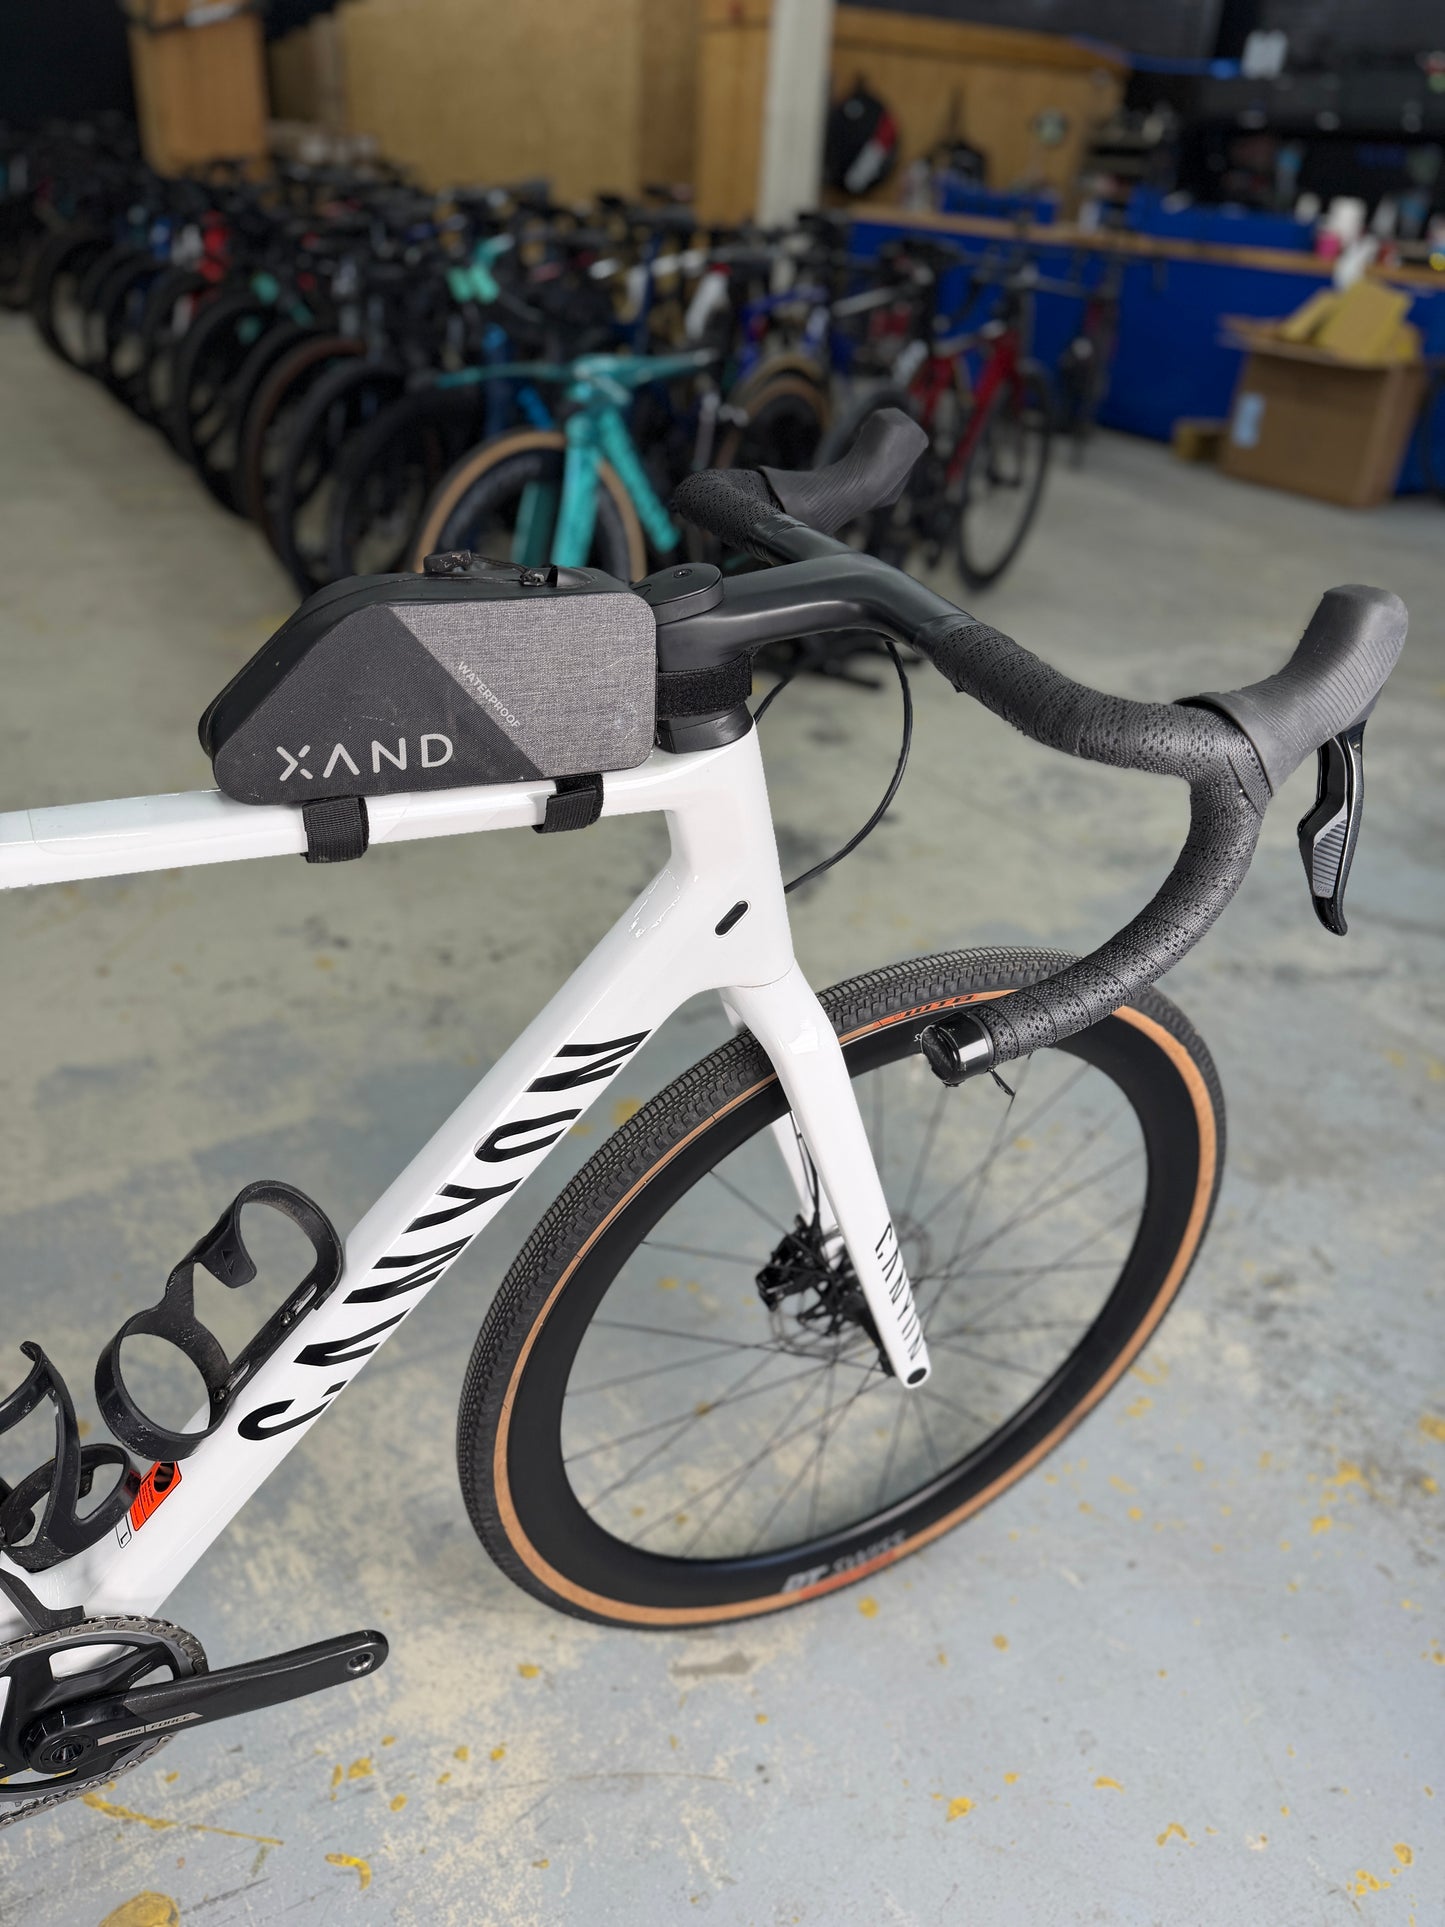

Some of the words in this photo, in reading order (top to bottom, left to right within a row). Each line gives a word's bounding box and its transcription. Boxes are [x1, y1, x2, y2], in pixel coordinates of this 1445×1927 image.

[459, 661, 521, 727] WATERPROOF
[276, 733, 453, 781] XAND
[238, 1029, 652, 1440] CANYON
[151, 1715, 191, 1729] FORCE
